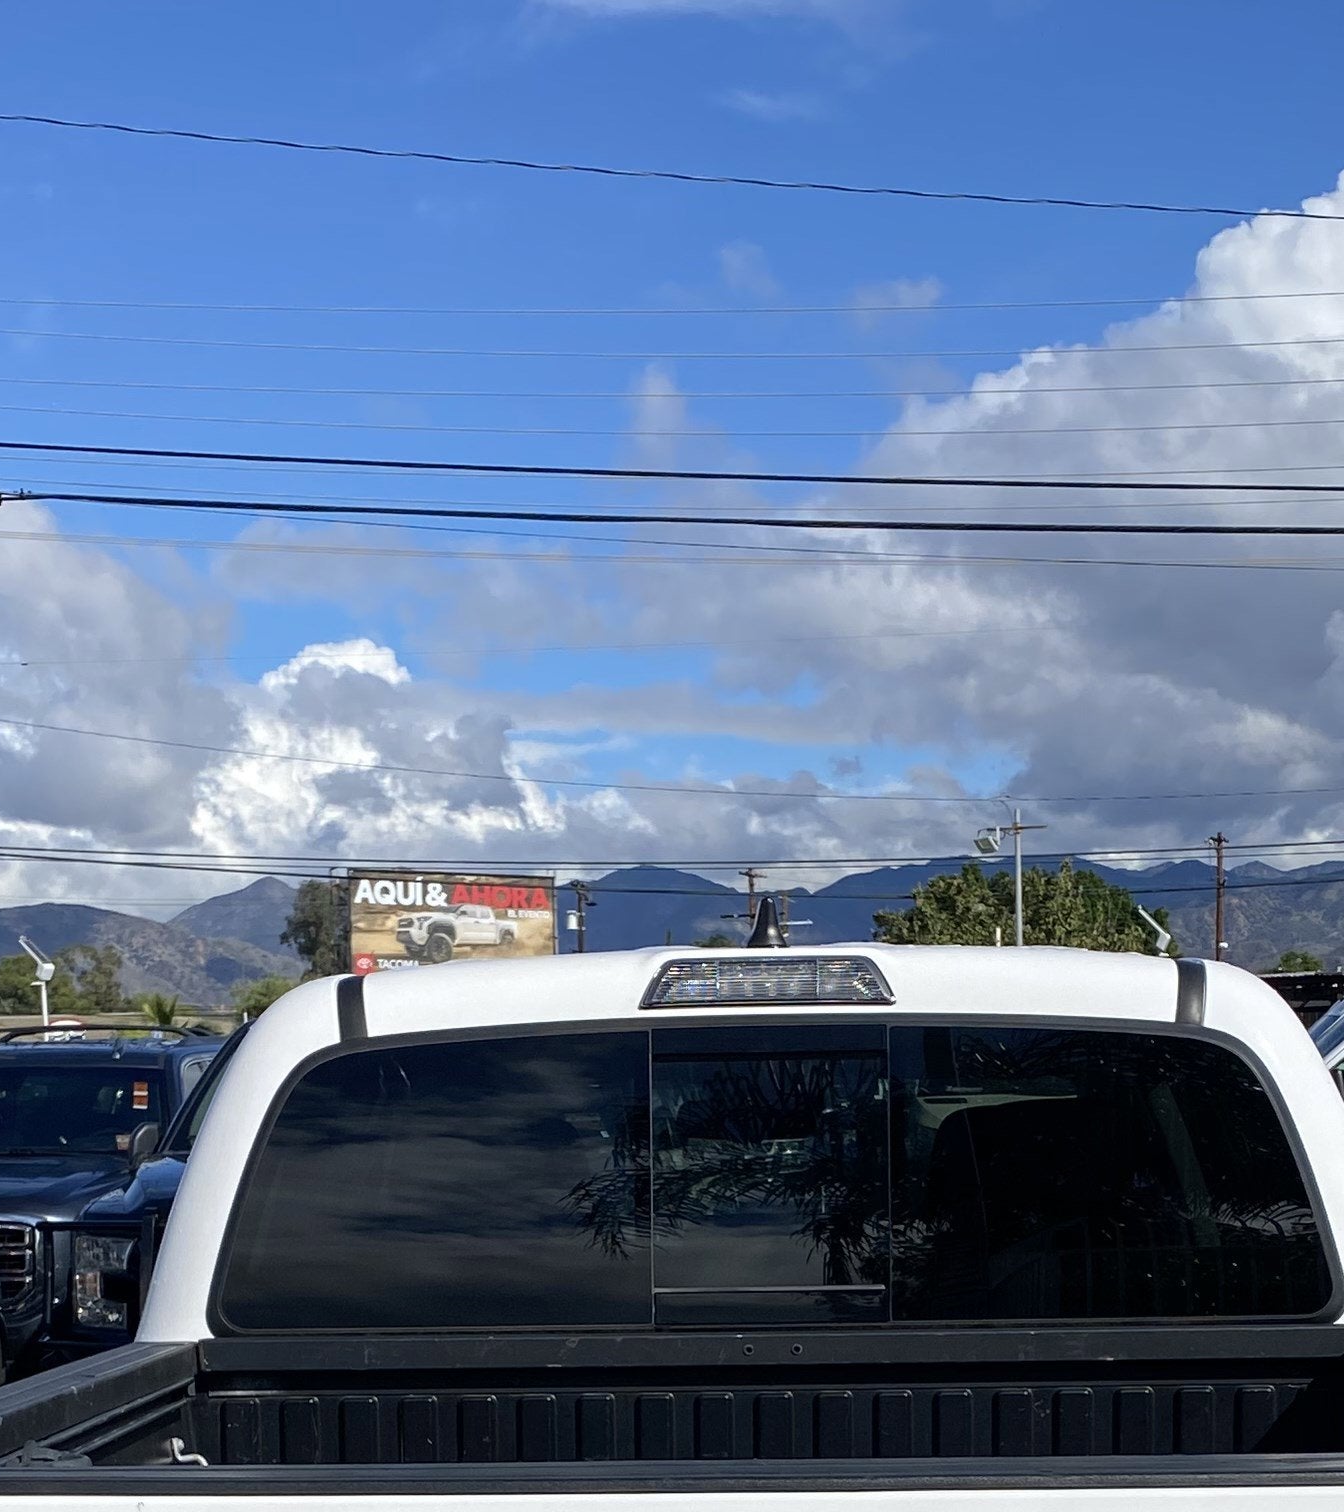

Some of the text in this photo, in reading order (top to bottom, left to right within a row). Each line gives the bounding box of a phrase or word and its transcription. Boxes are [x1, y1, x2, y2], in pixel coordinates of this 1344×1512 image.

[354, 876, 550, 909] AQUÍ & AHORA
[376, 959, 419, 969] TACOMA
